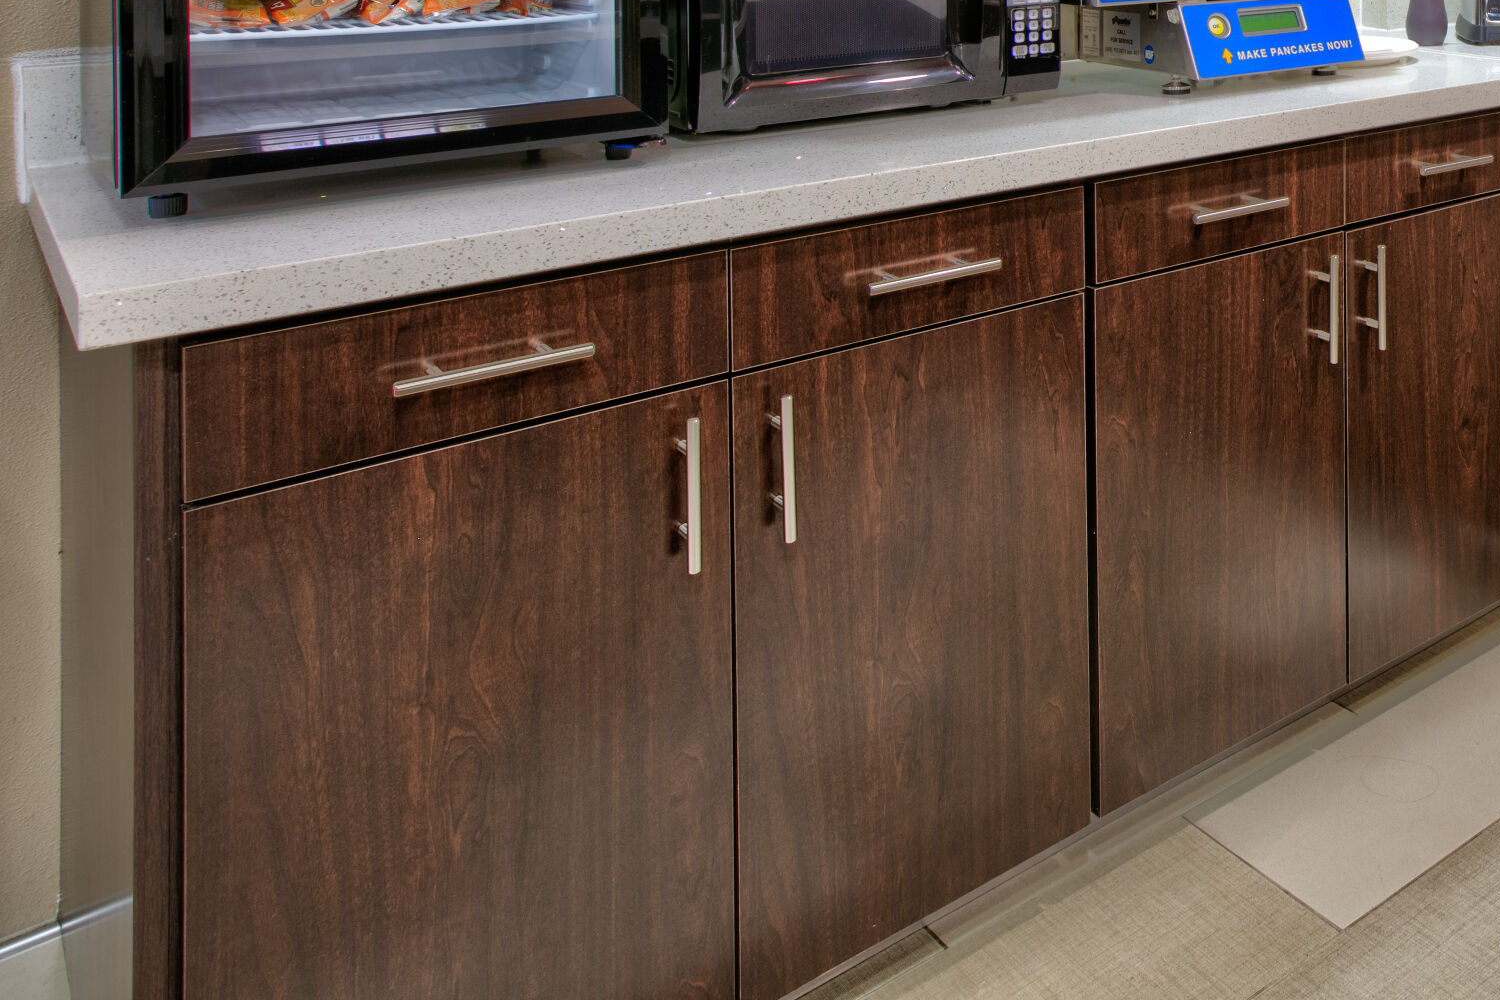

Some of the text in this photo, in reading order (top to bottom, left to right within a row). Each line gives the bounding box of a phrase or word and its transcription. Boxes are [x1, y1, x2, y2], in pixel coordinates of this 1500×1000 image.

[1237, 39, 1353, 60] MAKE PANCAKES NOW!
